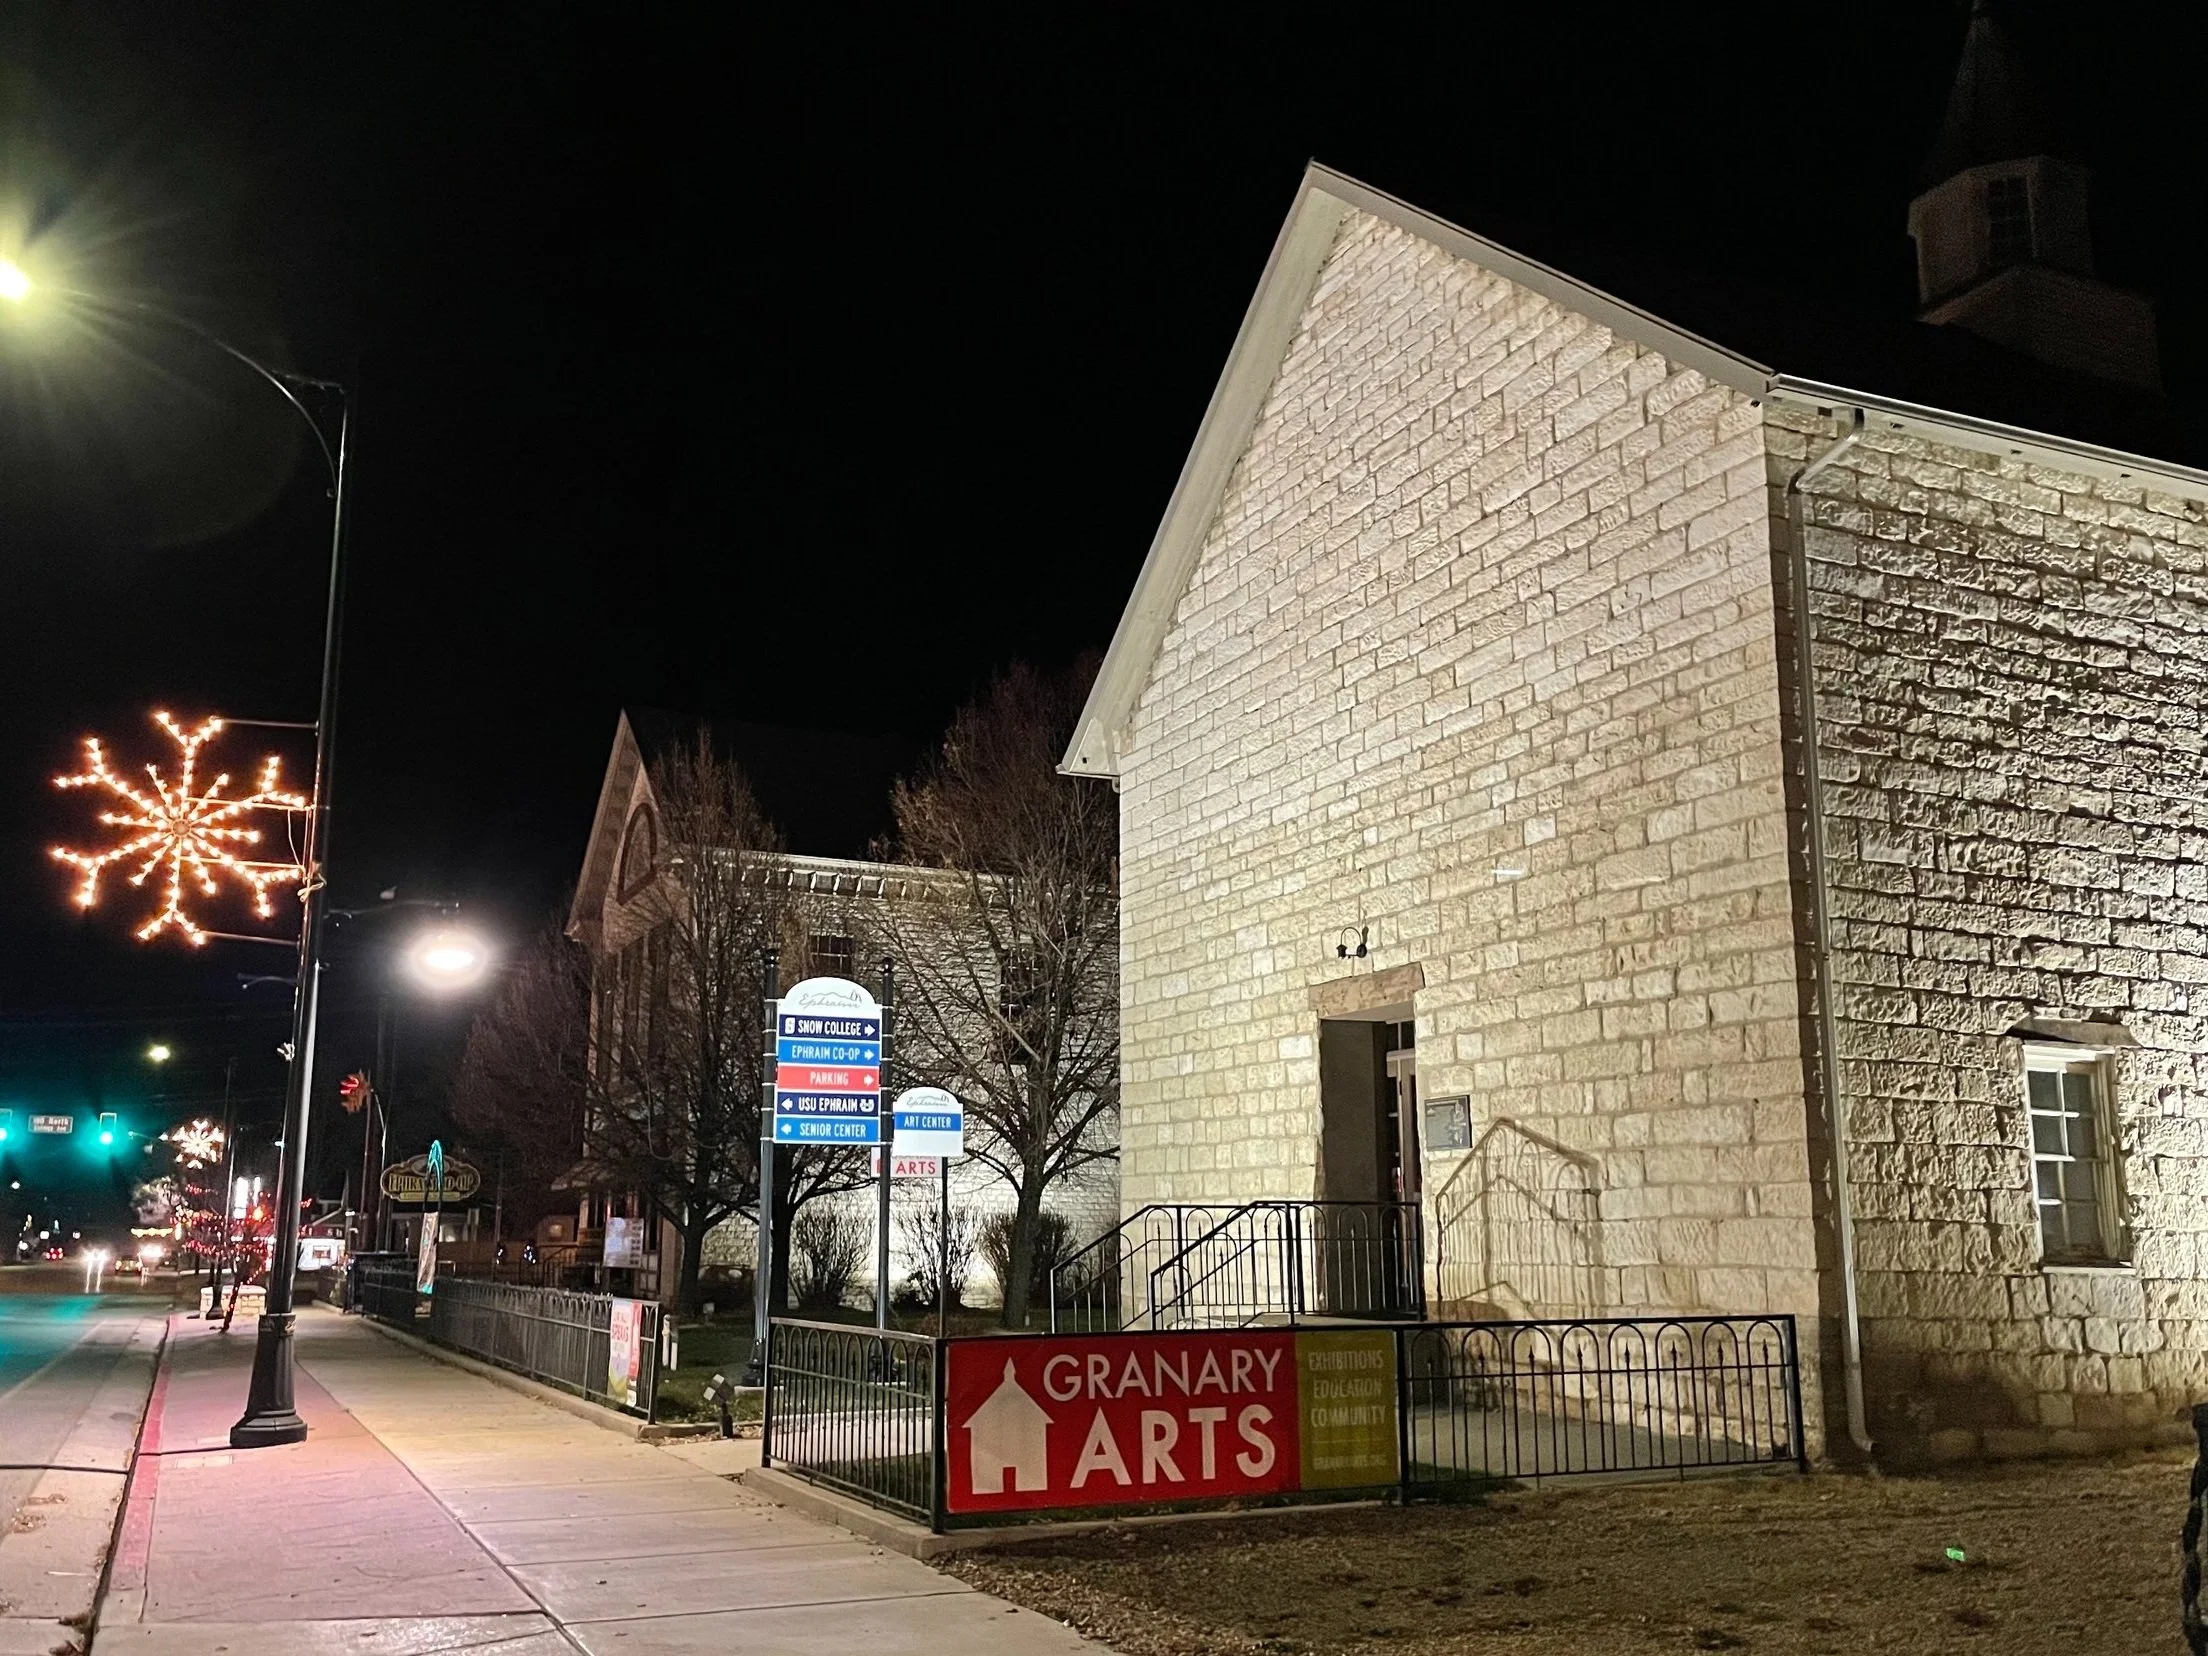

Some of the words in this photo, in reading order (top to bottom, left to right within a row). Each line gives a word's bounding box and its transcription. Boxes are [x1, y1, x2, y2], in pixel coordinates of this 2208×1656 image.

[798, 992, 861, 1010] Ephraim
[798, 1019, 823, 1034] SNOW
[824, 1021, 862, 1036] COLLEGE
[792, 1045, 830, 1060] EPHRAIM
[832, 1047, 861, 1061] CO-OP
[810, 1071, 849, 1086] PARKING
[798, 1097, 817, 1112] USU
[818, 1097, 858, 1113] EPHRAIM
[799, 1123, 833, 1137] SENIOR
[834, 1124, 867, 1138] CENTER
[904, 1115, 920, 1128] ART
[921, 1116, 952, 1129] CENTER
[895, 1160, 936, 1175] ARTS
[388, 1173, 439, 1191] EPHRA
[1308, 1350, 1385, 1371] EXHIBITIONS
[1043, 1348, 1282, 1401] GRANARY
[1313, 1376, 1382, 1399] EDUCATION
[1310, 1404, 1386, 1428] COMMUNITY
[1069, 1404, 1276, 1488] ARTS
